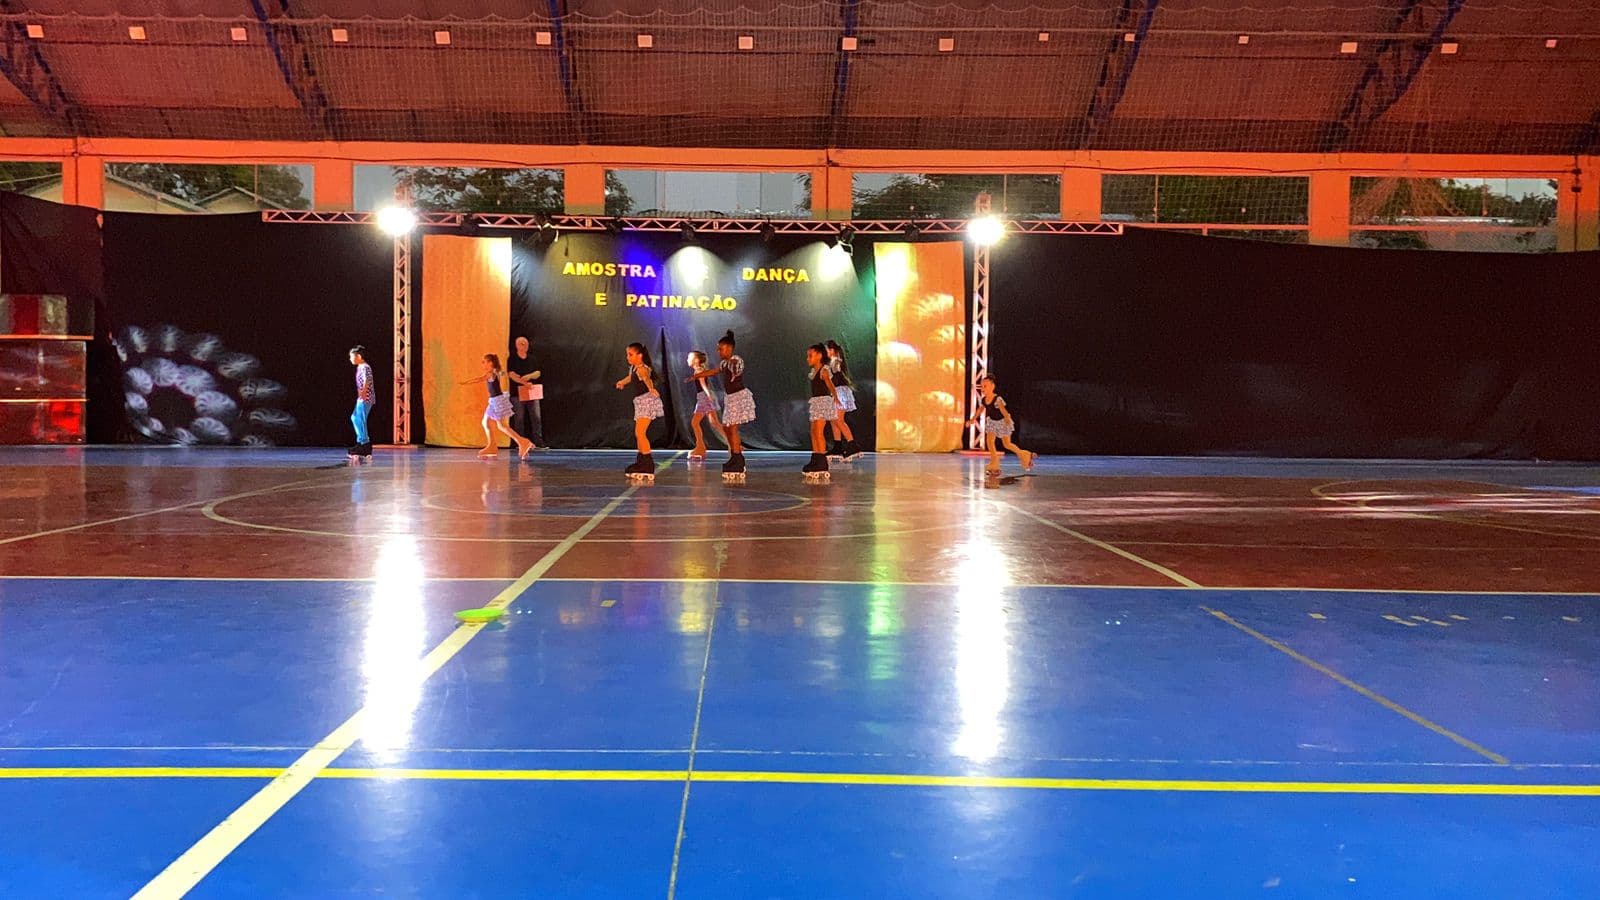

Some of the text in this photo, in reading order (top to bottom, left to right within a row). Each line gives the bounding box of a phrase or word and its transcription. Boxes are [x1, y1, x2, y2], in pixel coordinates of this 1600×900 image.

[562, 261, 810, 284] AMOSTRA DANÇA
[594, 292, 737, 311] E PATINAÇÃO
